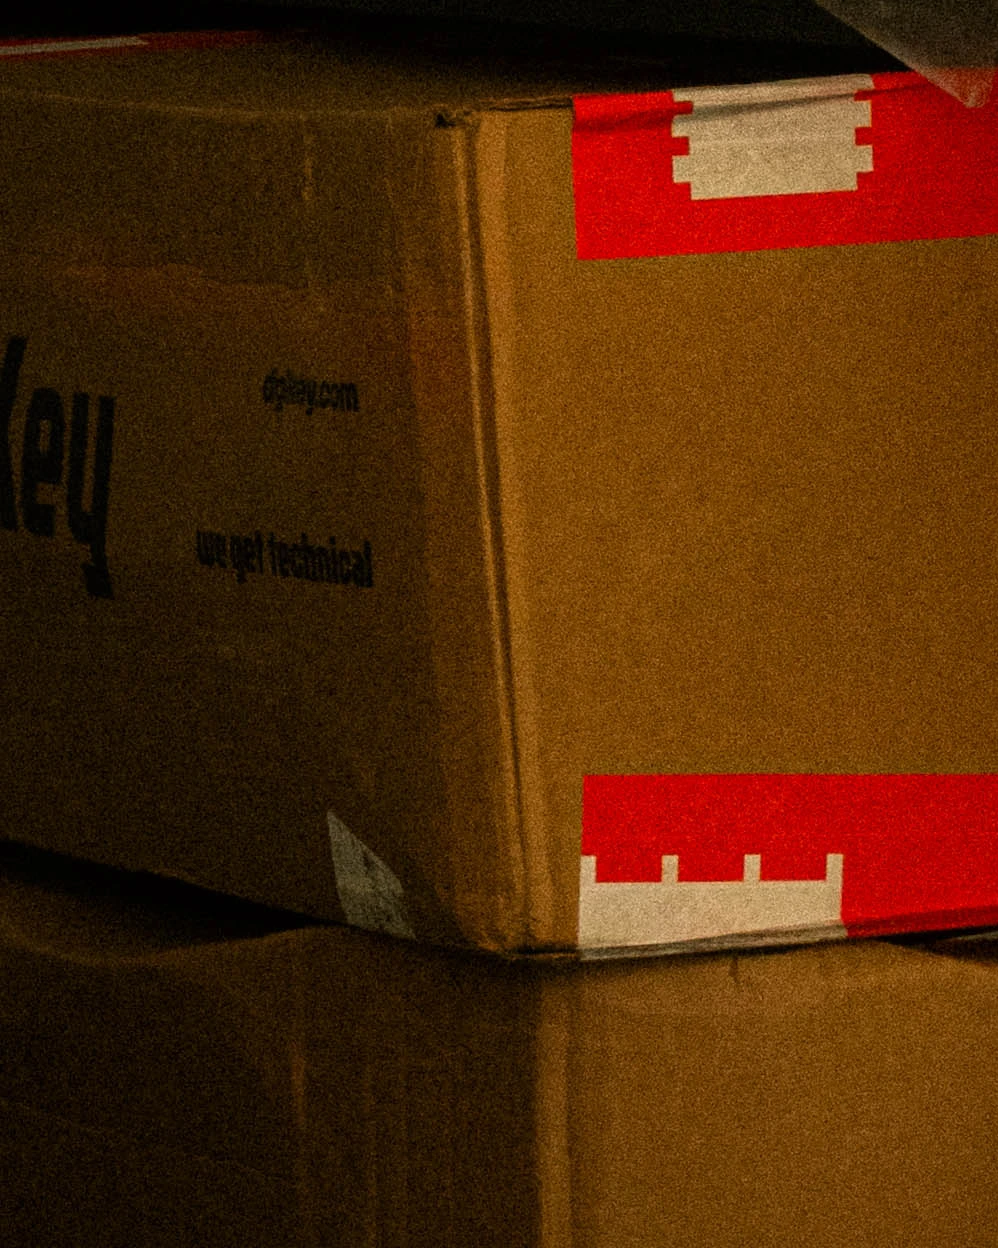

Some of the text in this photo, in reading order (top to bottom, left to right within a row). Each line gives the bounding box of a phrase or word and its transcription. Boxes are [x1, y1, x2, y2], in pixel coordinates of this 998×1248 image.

[197, 529, 373, 588] we get technical
